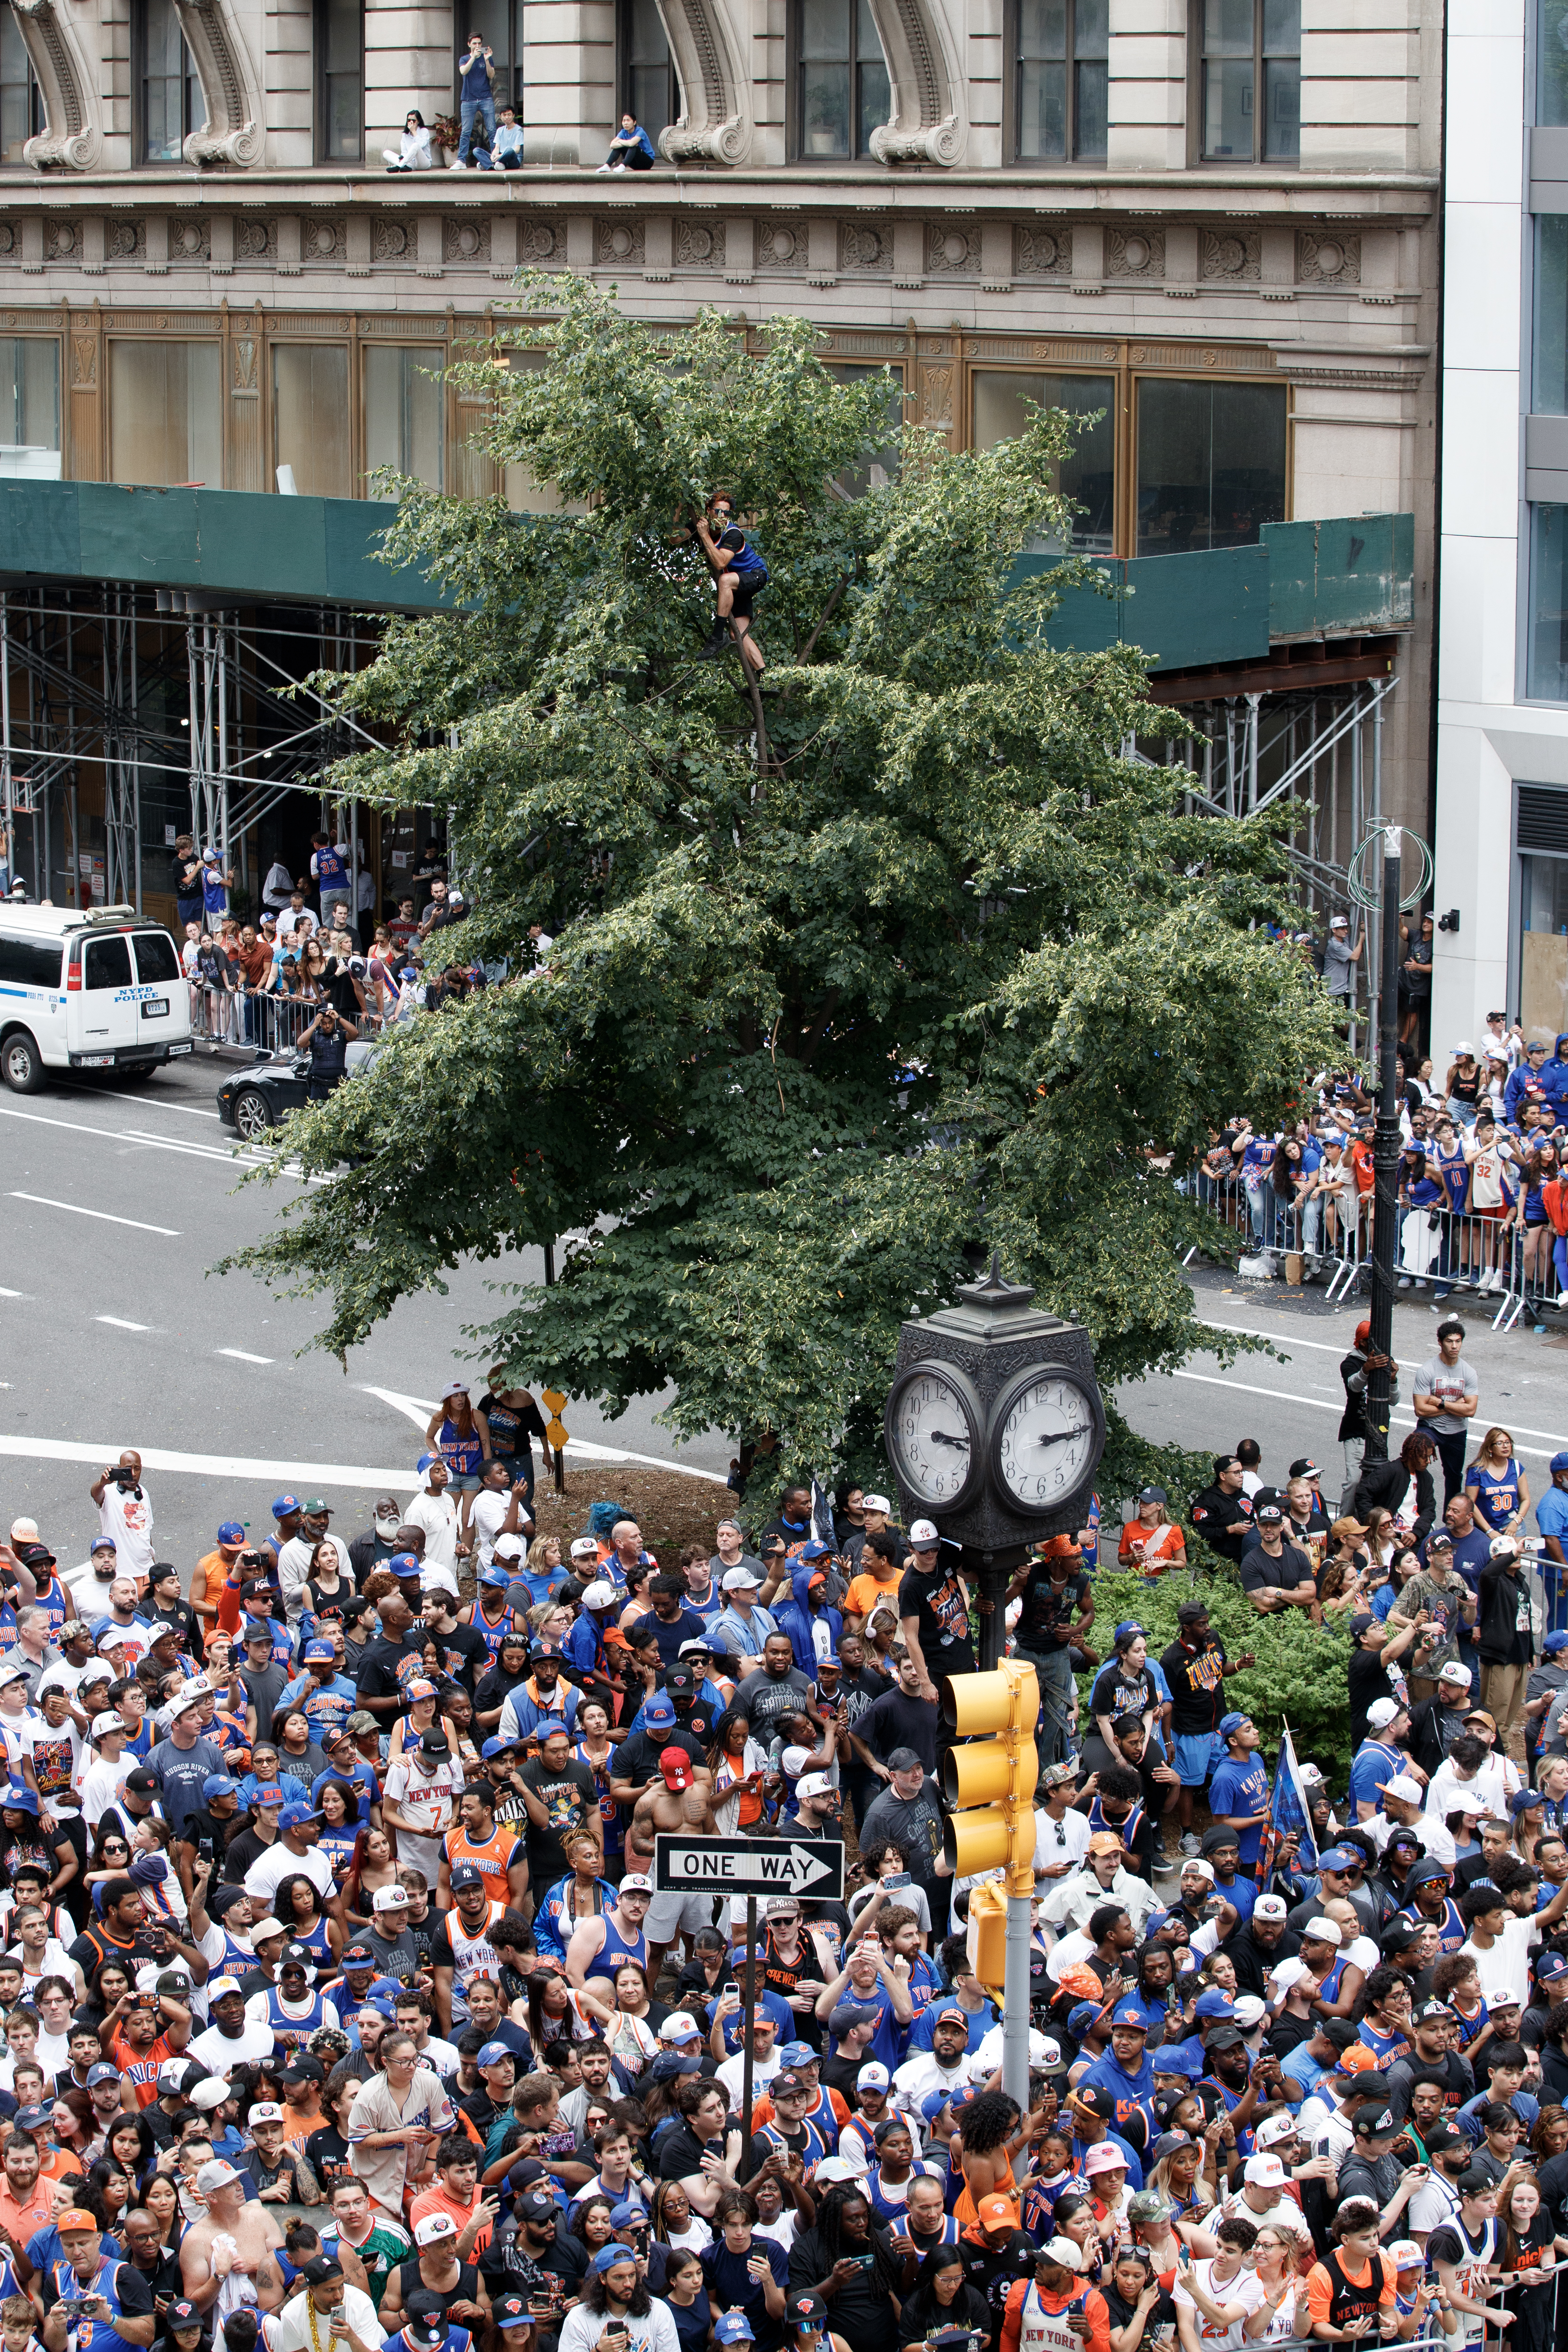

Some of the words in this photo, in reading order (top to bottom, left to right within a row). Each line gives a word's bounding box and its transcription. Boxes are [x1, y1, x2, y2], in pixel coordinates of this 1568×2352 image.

[320, 860, 338, 875] 32
[114, 992, 158, 1002] POLICE
[119, 987, 153, 996] NYPD
[1261, 1149, 1271, 1161] 11
[1441, 1163, 1452, 1171] NEW
[1477, 1165, 1491, 1178] 32
[1451, 1171, 1463, 1187] 11
[922, 1384, 930, 1401] 11
[936, 1381, 947, 1401] 12
[1036, 1385, 1048, 1403] 12
[1058, 1389, 1064, 1405] 1
[910, 1396, 921, 1415] 10
[1018, 1395, 1028, 1413] 11
[1069, 1401, 1077, 1418] 2
[489, 1413, 515, 1427] CLUTCH
[490, 1405, 521, 1426] CAPTAIN
[1006, 1414, 1017, 1432] 10
[906, 1418, 914, 1436] 9
[441, 1443, 457, 1452] NEW
[459, 1441, 479, 1451] YORK
[910, 1443, 919, 1461] 8
[1002, 1439, 1010, 1456] 9
[449, 1455, 467, 1474] 11
[1066, 1449, 1076, 1465] 4
[921, 1464, 928, 1482] 7
[1007, 1461, 1015, 1479] 8
[1055, 1467, 1064, 1484] 5
[936, 1474, 944, 1492] 6
[951, 1472, 960, 1490] 5
[1019, 1476, 1028, 1494] 7
[1037, 1476, 1046, 1494] 6
[1486, 1486, 1500, 1495] NEW
[1501, 1485, 1516, 1493] YORK
[1491, 1493, 1512, 1512] 30
[18, 1529, 36, 1537] Knicks
[930, 1579, 958, 1612] NBA
[320, 1606, 334, 1619] NEW
[397, 1653, 423, 1676] KNICKS
[1186, 1652, 1223, 1691] KNICKS
[1115, 1685, 1149, 1706] FINALS
[306, 1699, 352, 1712] CHAMPS
[165, 1763, 189, 1777] HUDSON
[191, 1763, 210, 1776] RIVER
[675, 1767, 683, 1776] NY
[408, 1790, 431, 1803] NEW
[433, 1785, 452, 1797] YORK
[558, 1783, 578, 1796] YORK
[429, 1806, 443, 1830] 7
[317, 1839, 336, 1848] NEW
[1103, 1835, 1113, 1843] NY
[451, 1857, 473, 1868] NEW
[474, 1861, 502, 1875] YORK
[462, 1868, 472, 1877] NY
[684, 1853, 735, 1877] ONE
[760, 1857, 814, 1880] WAY
[1443, 1936, 1463, 1950] YORK
[456, 1956, 474, 1970] NEW
[610, 1953, 626, 1965] NEW
[224, 1962, 245, 1975] NEW
[176, 1976, 185, 1986] NY
[1378, 2051, 1395, 2070] NEW
[1395, 2042, 1411, 2057] YORK
[1035, 2195, 1054, 2216] YORK
[727, 2319, 743, 2327] FINALS
[1336, 2309, 1355, 2321] NEW
[1026, 2329, 1045, 2342] NEW
[1047, 2331, 1076, 2350] YORK
